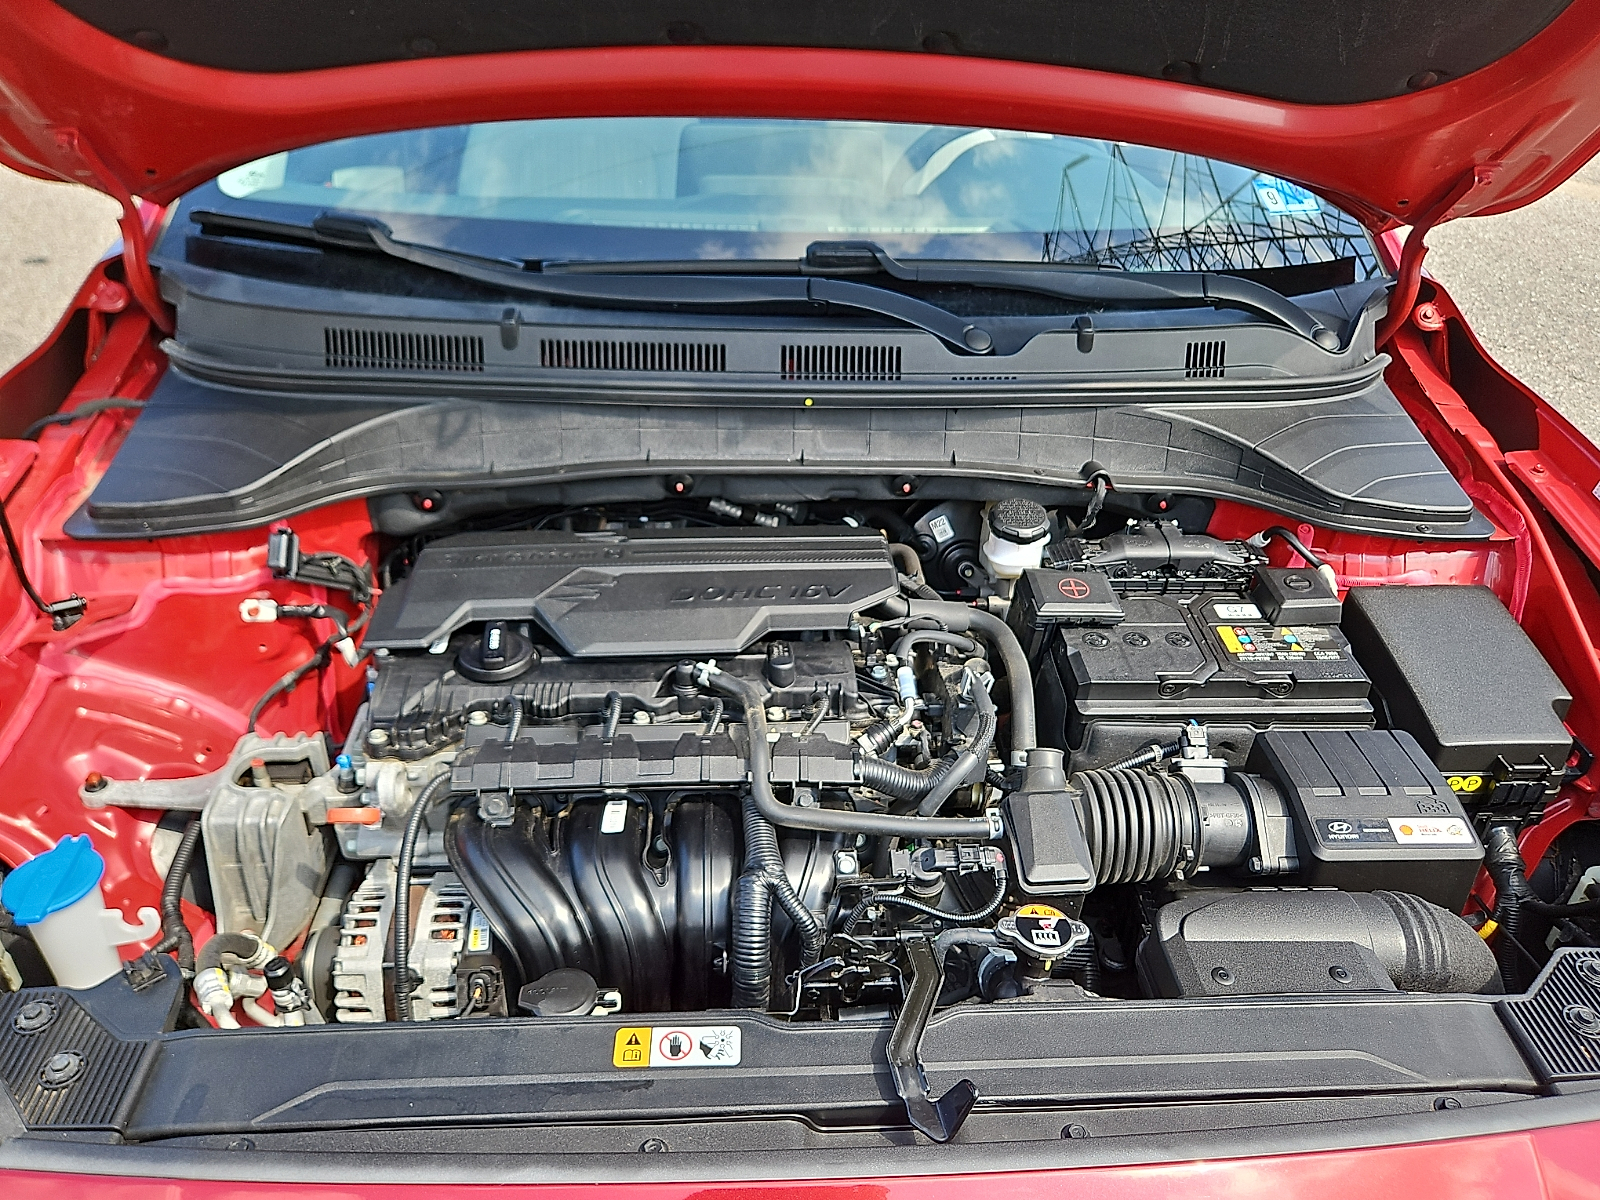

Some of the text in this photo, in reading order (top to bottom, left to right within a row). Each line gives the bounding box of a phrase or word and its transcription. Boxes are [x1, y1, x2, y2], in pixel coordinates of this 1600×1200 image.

[931, 518, 946, 530] M22
[670, 584, 853, 602] DOHC 16V
[1467, 779, 1478, 788] P
